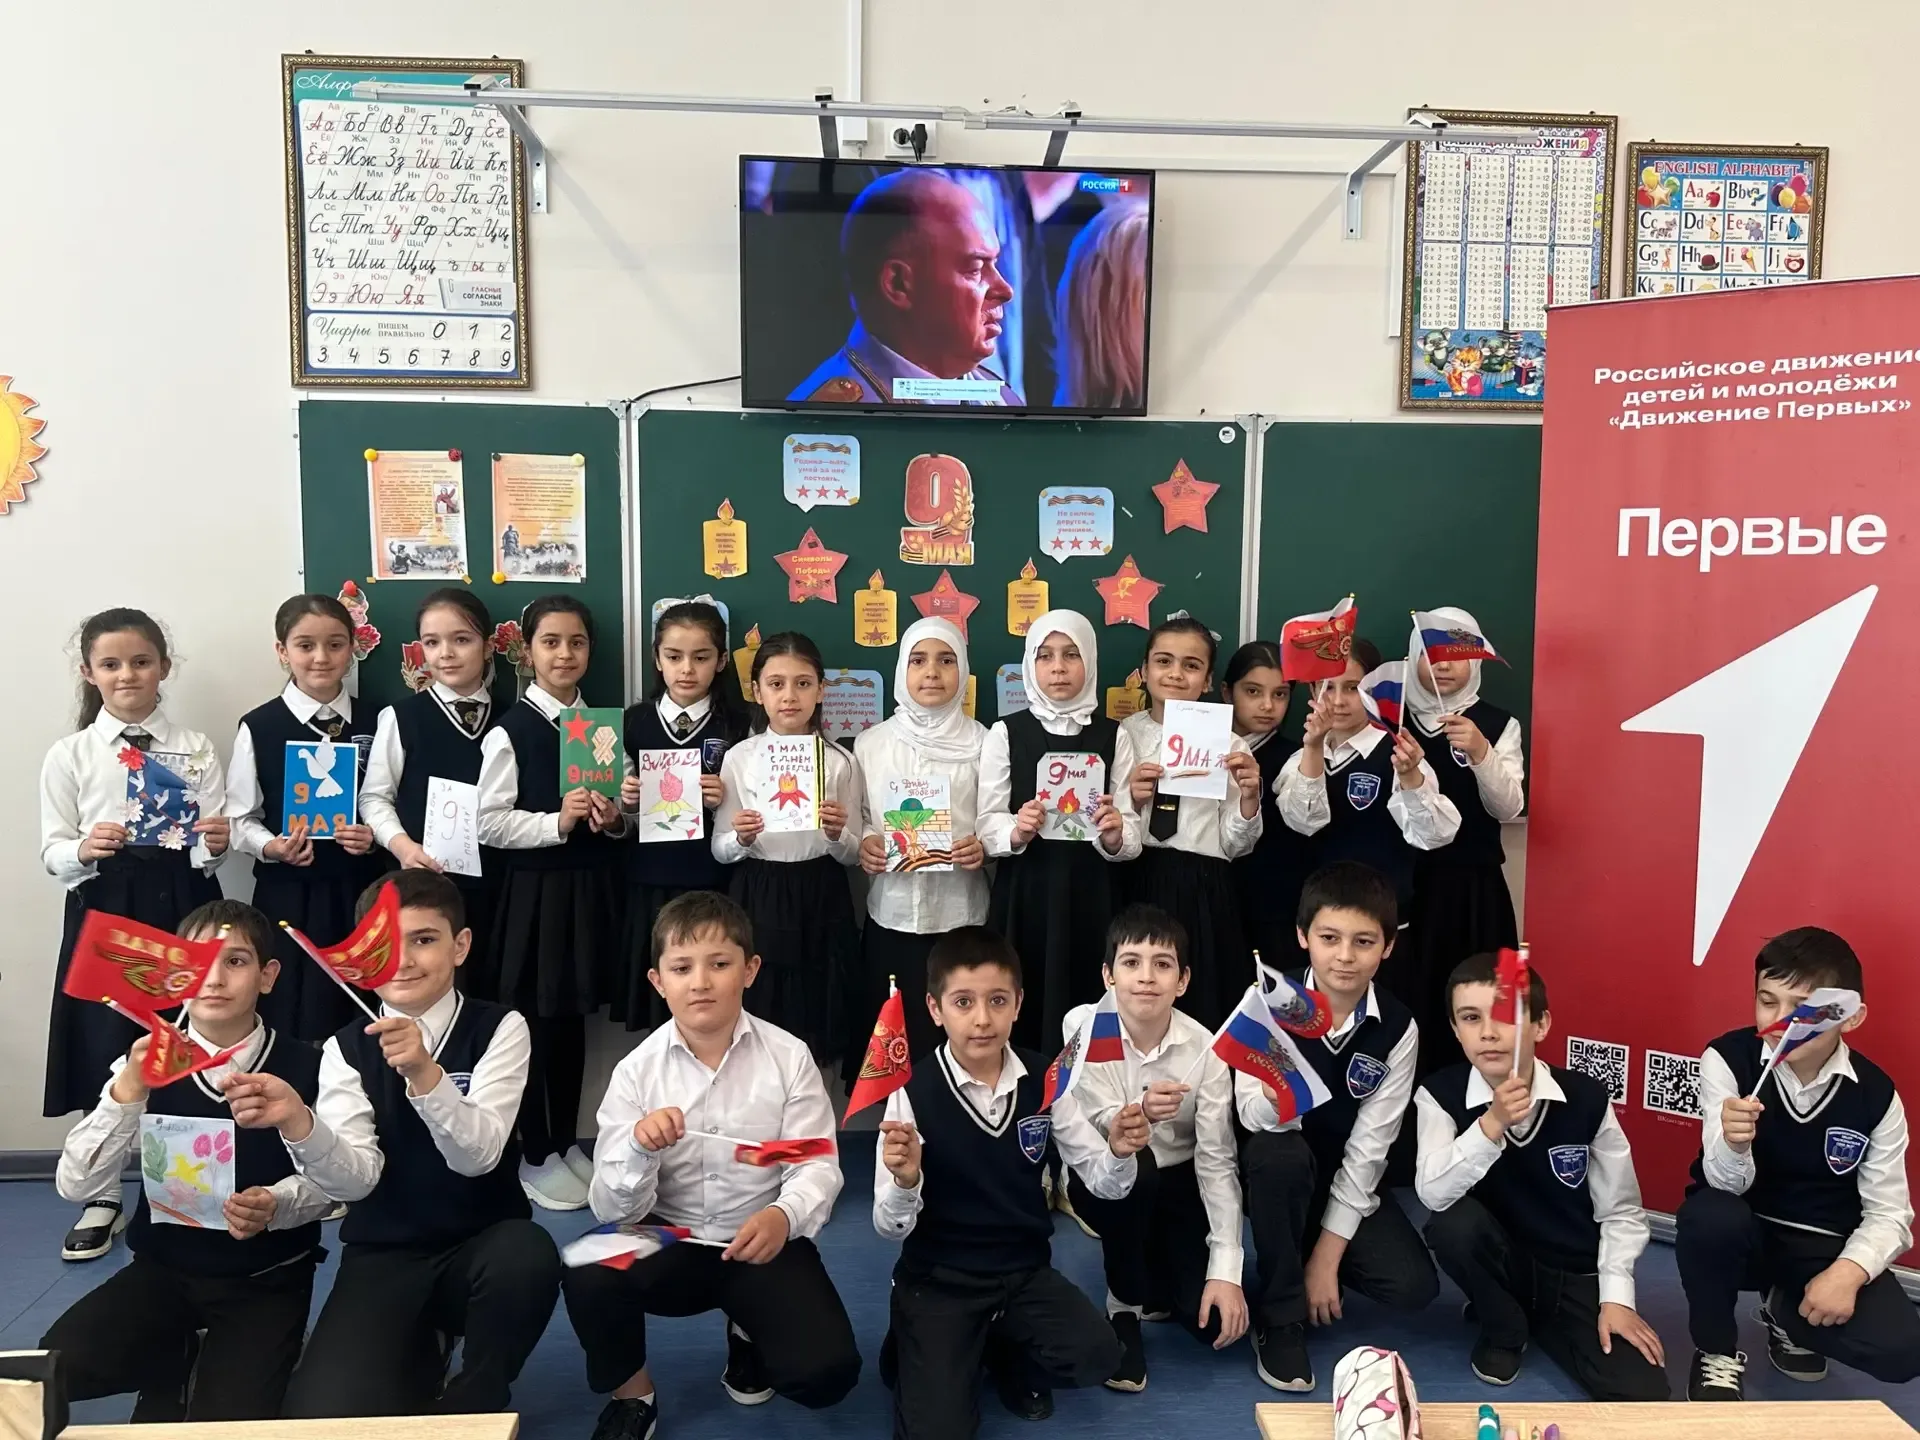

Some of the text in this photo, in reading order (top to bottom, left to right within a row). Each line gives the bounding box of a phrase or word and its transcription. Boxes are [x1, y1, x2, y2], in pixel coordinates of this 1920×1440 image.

[306, 111, 505, 145] Аа Бб Вв Гг Дд Ее
[305, 142, 508, 175] Ёё Жж Зз Ии Йй Кк
[1655, 162, 1800, 177] ENGLISH ALPHABET
[308, 180, 509, 210] Лл Мм Нн Оо Пп Рр
[1082, 180, 1129, 192] РОССИЯ 1
[1685, 181, 1746, 199] Aa Bb
[309, 213, 509, 244] Сс Тт Уу Фф Хх Цц
[1640, 211, 1784, 231] Cc Dd Ee Ff
[312, 248, 335, 268] Чч
[347, 249, 386, 269] Шш
[397, 250, 436, 275] Щщ
[1639, 244, 1780, 268] Gg Hh Ii Jj
[313, 283, 424, 305] Ээ Юю Яя
[1637, 276, 1655, 293] Kk
[312, 316, 371, 345] Цифры
[433, 322, 511, 341] 0 1 2
[317, 347, 511, 367] 3 4 5 6 7 8 9
[1594, 349, 1920, 384] Российское движени
[1622, 374, 1898, 407] детей и молодёжи
[1609, 399, 1912, 430] «Движение Первых»
[903, 455, 968, 552] 9
[1617, 507, 1887, 572] Первые
[791, 555, 832, 563] Символы
[922, 542, 972, 564] МАЯ
[795, 567, 832, 575] Победы
[770, 755, 775, 763] С
[780, 743, 804, 753] МАЯ
[1167, 734, 1225, 768] 9 МАЯ
[567, 764, 614, 784] 9 МАЯ
[1048, 762, 1068, 786] 9
[294, 782, 310, 804] 9
[288, 813, 347, 834] МАЯ
[441, 800, 458, 840] 9
[1246, 1052, 1288, 1090] РОССИЯ
